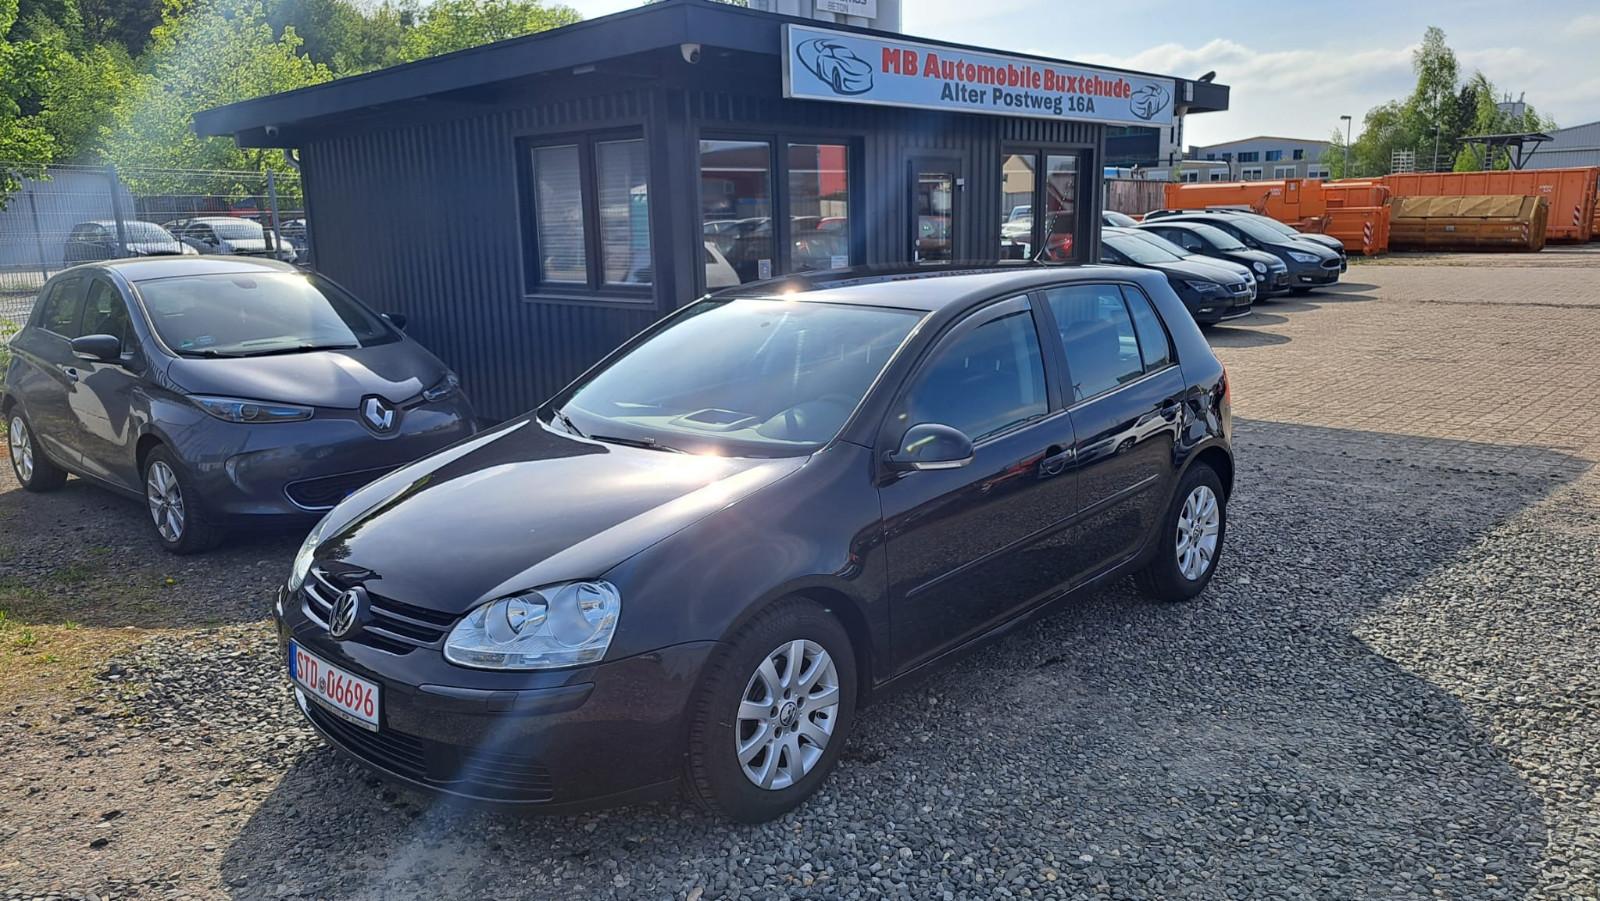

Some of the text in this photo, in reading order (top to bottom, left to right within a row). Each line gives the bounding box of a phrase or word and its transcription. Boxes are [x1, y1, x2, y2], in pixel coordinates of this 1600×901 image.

[881, 47, 1131, 98] MB Automobile Buxtehude
[940, 82, 1095, 115] Alter Postweg 16A
[297, 651, 318, 689] STD
[326, 669, 374, 717] 06696
